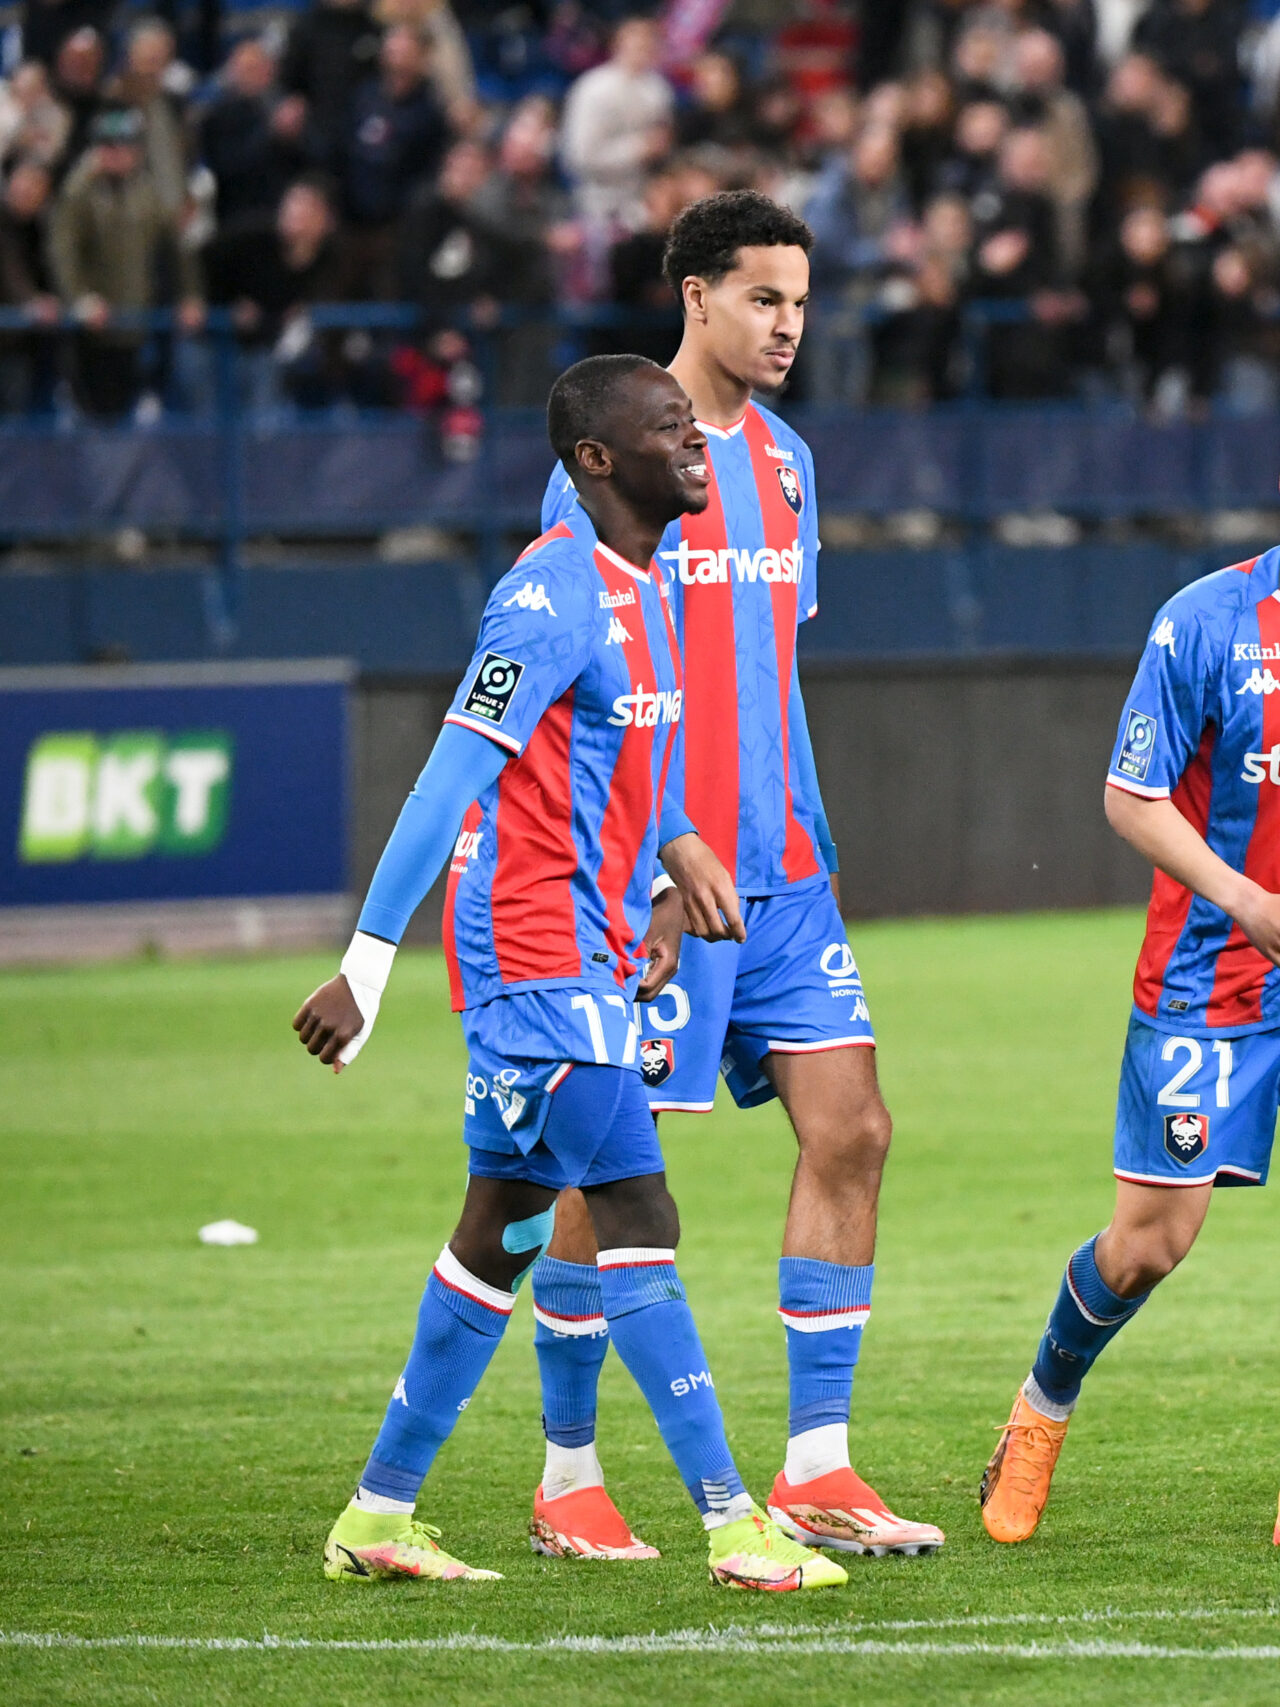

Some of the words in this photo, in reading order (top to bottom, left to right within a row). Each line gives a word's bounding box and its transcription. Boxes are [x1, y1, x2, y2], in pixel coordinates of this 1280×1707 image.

[659, 539, 804, 585] tarwash
[470, 702, 497, 718] BKT
[472, 692, 498, 707] LIGUE
[497, 702, 505, 710] 2
[21, 738, 234, 850] BKT
[570, 993, 638, 1065] 17
[1157, 1035, 1233, 1108] 21
